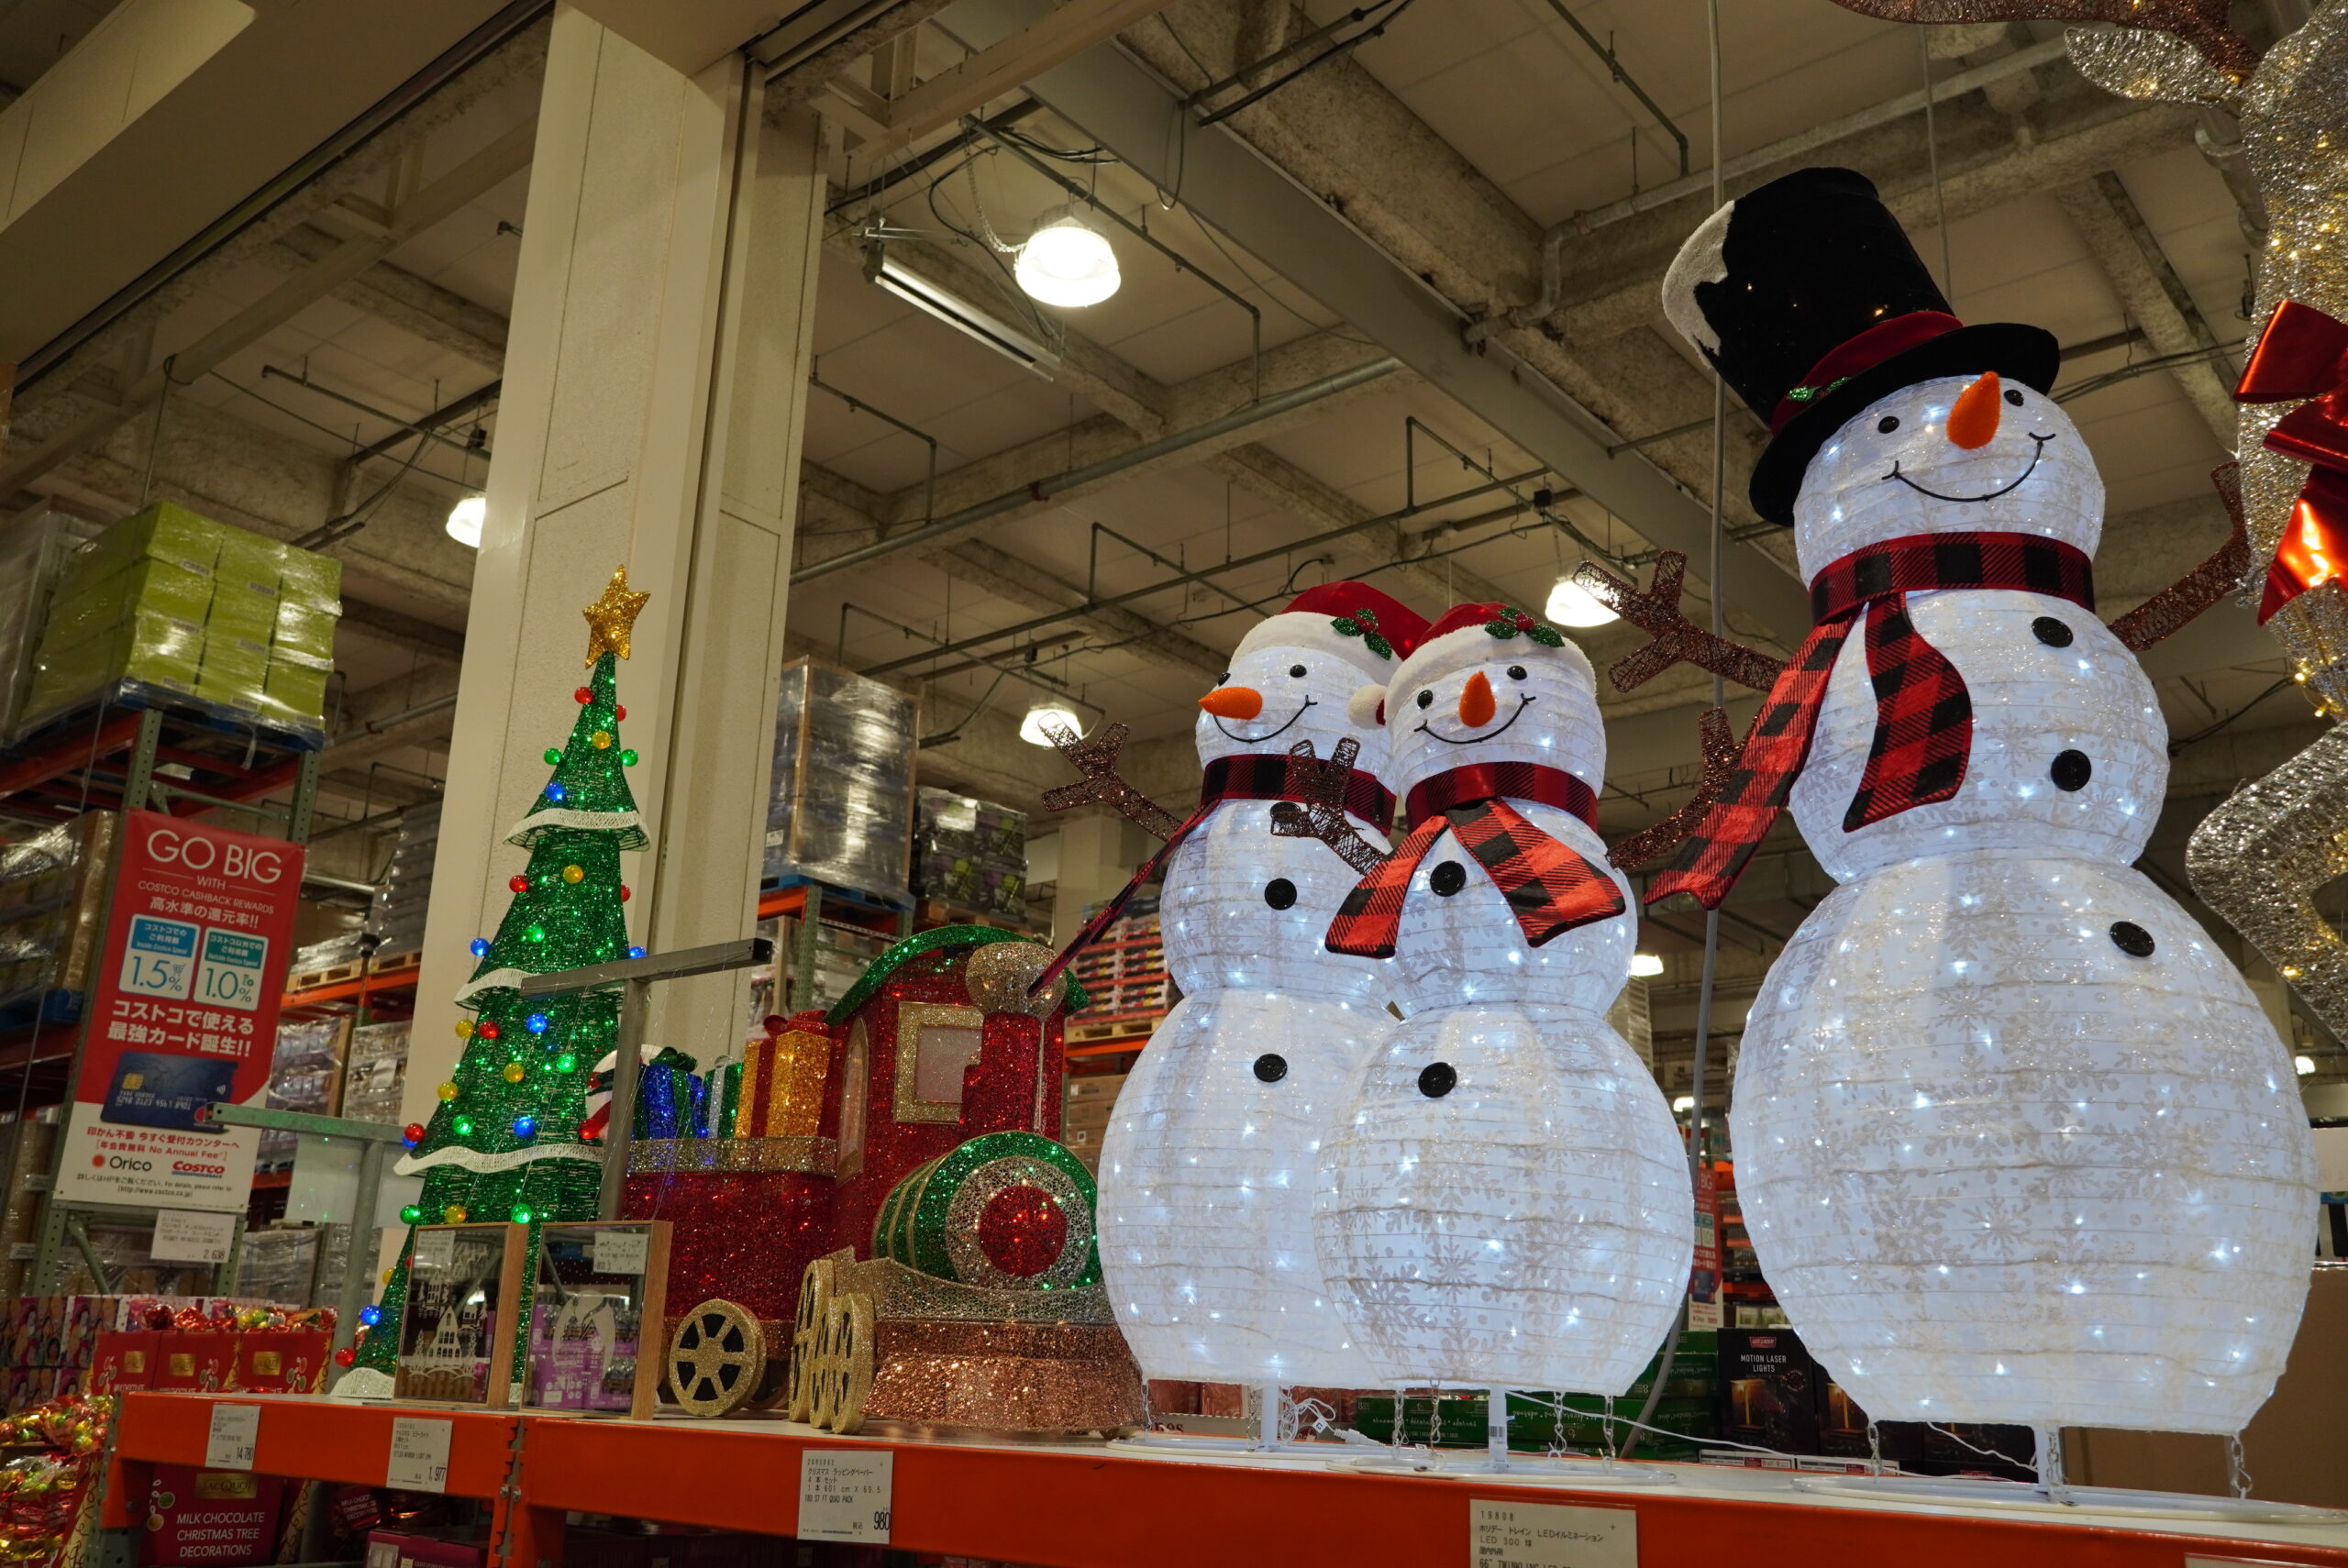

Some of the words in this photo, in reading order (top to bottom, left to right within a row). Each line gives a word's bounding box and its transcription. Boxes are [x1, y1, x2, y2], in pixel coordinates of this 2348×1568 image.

[147, 830, 216, 869] GO
[224, 844, 282, 883] BIG
[197, 875, 226, 890] WITH
[138, 880, 180, 896] COSTCO
[182, 889, 231, 906] CASHBACK
[233, 898, 274, 914] REWARDS
[112, 999, 254, 1035] コストコで使える
[109, 1155, 152, 1172] Orico
[172, 1160, 226, 1175] COSTCO
[1740, 1354, 1765, 1363] MOTION
[1767, 1354, 1787, 1364] LASER
[1753, 1364, 1776, 1373] LIGHTS
[833, 1468, 873, 1476] ラッピングペーパー
[825, 1476, 837, 1485] セット
[176, 1513, 202, 1524] MILK
[203, 1511, 265, 1524] CHOCOLATE
[874, 1511, 891, 1530] 980
[177, 1529, 234, 1540] CHRISTMAS
[236, 1528, 260, 1539] TREE
[1480, 1535, 1497, 1544] LED
[1503, 1537, 1520, 1546] 300
[1509, 1526, 1531, 1535] トレイン
[1537, 1529, 1604, 1542] LEDイルミネーション
[179, 1544, 252, 1557] DECORATIONS
